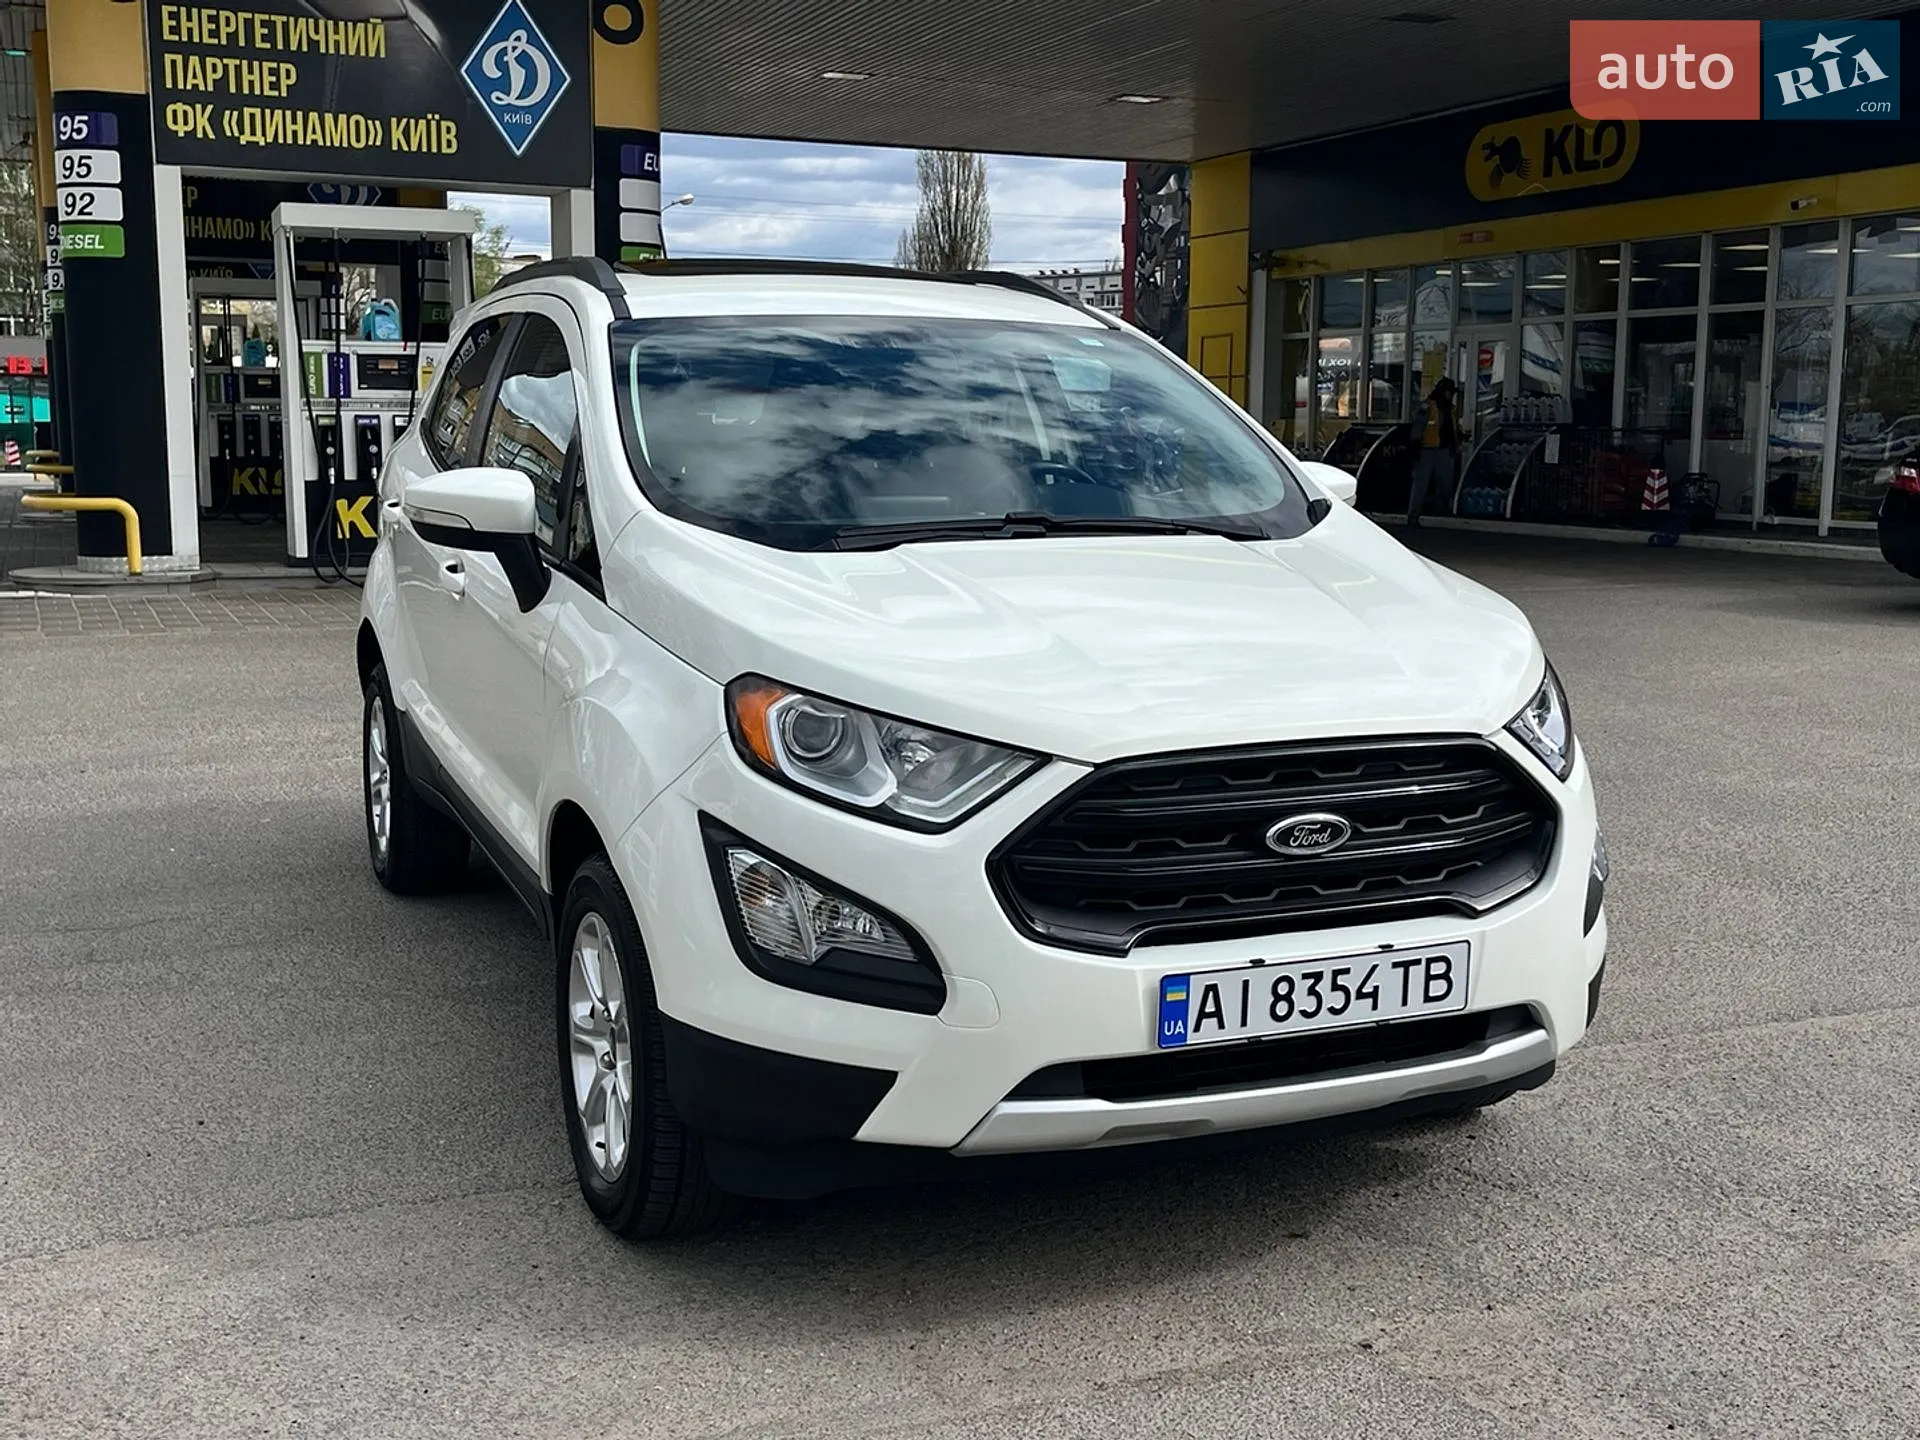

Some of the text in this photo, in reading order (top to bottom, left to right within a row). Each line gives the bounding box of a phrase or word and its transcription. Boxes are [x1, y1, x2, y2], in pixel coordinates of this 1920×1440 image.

[161, 4, 386, 59] ЕНЕРГЕТИЧНИЙ
[164, 53, 297, 97] ПАРТНЕР
[58, 115, 90, 141] 95
[166, 102, 458, 154] ФК «ДИНАМО» КИЇВ
[503, 112, 533, 126] КИЇВ
[62, 155, 93, 180] 95
[64, 192, 96, 217] 92
[1289, 824, 1331, 847] Ford
[1192, 954, 1454, 1034] AI 8354 TB
[1164, 1020, 1186, 1036] UA
